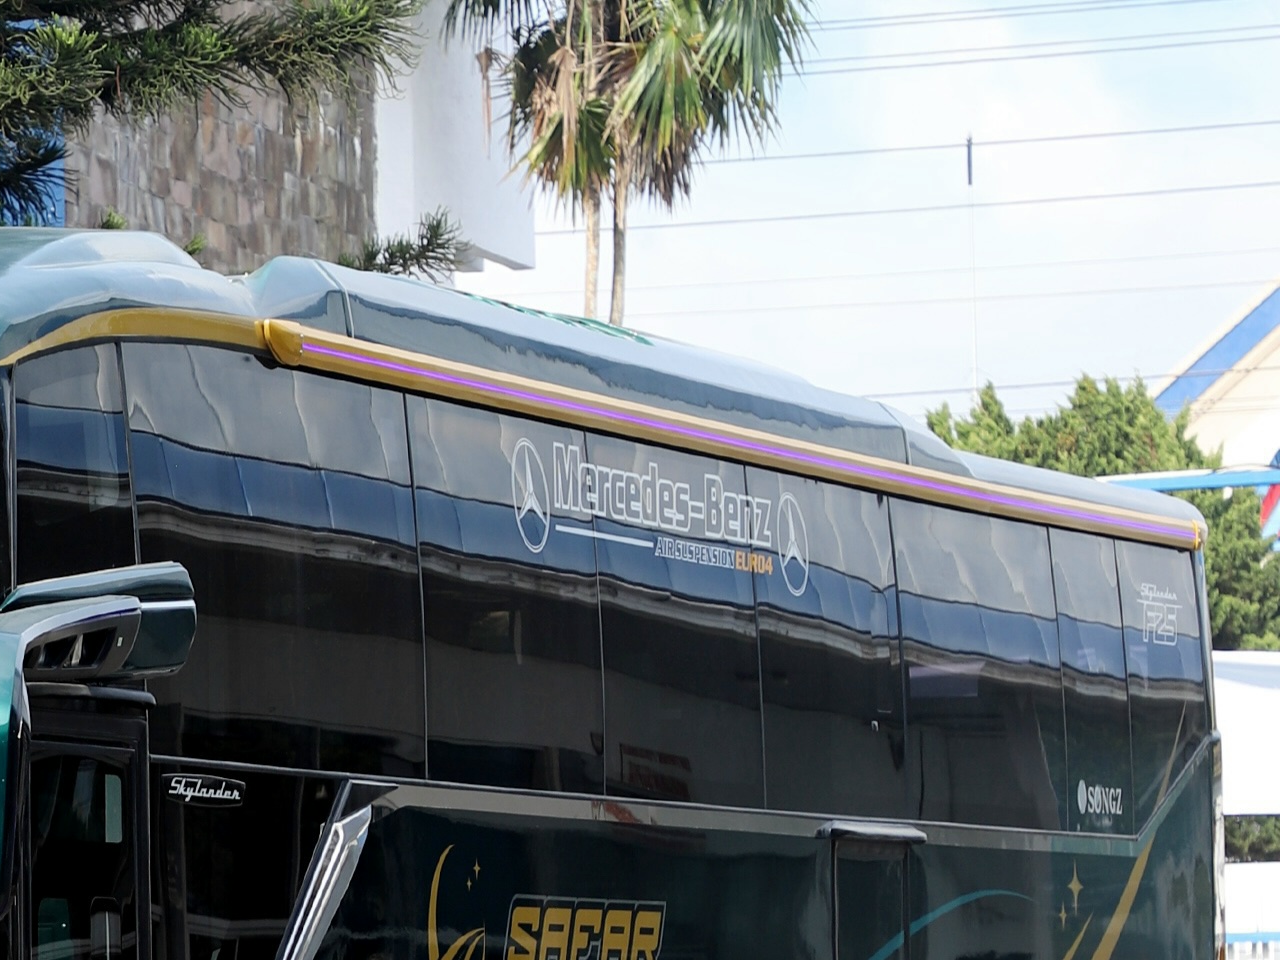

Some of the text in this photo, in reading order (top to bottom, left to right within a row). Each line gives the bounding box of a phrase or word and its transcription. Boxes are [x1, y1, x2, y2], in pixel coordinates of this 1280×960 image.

[552, 441, 773, 548] Mercedes-Benz
[655, 536, 675, 560] AIR
[675, 539, 735, 570] SUSPENSION
[1137, 599, 1183, 646] F25
[168, 776, 242, 802] Skylander
[1087, 785, 1123, 815] SONGZ
